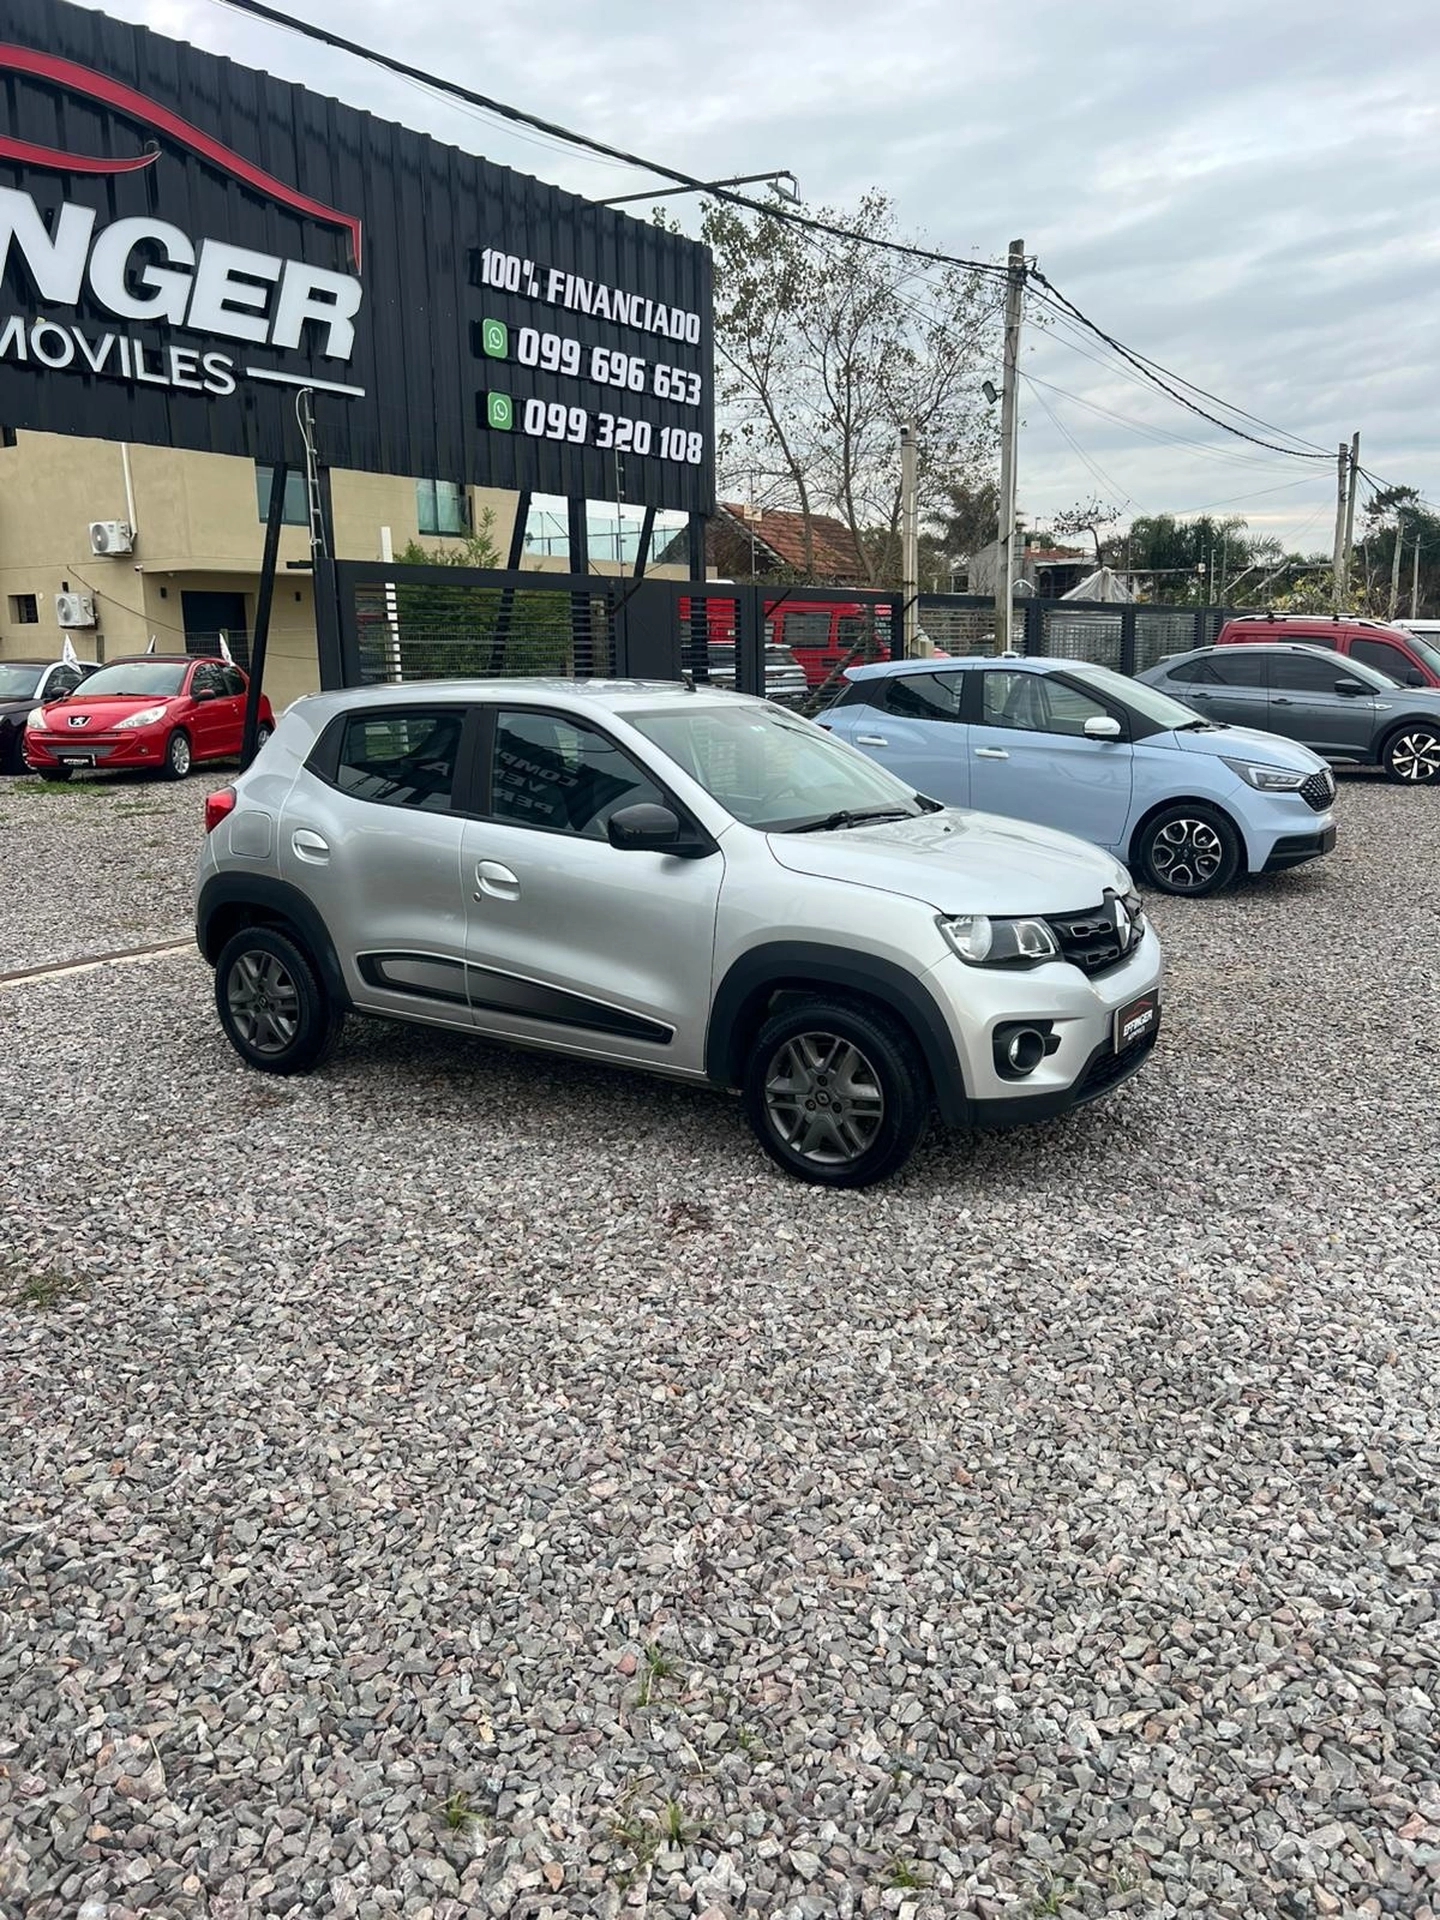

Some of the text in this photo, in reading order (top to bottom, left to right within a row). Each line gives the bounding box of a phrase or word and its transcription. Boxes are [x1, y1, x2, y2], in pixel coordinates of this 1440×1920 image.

[481, 248, 700, 345] 100% FINANCIADO
[517, 327, 702, 406] 099 696 653
[523, 398, 703, 465] 099 320 108
